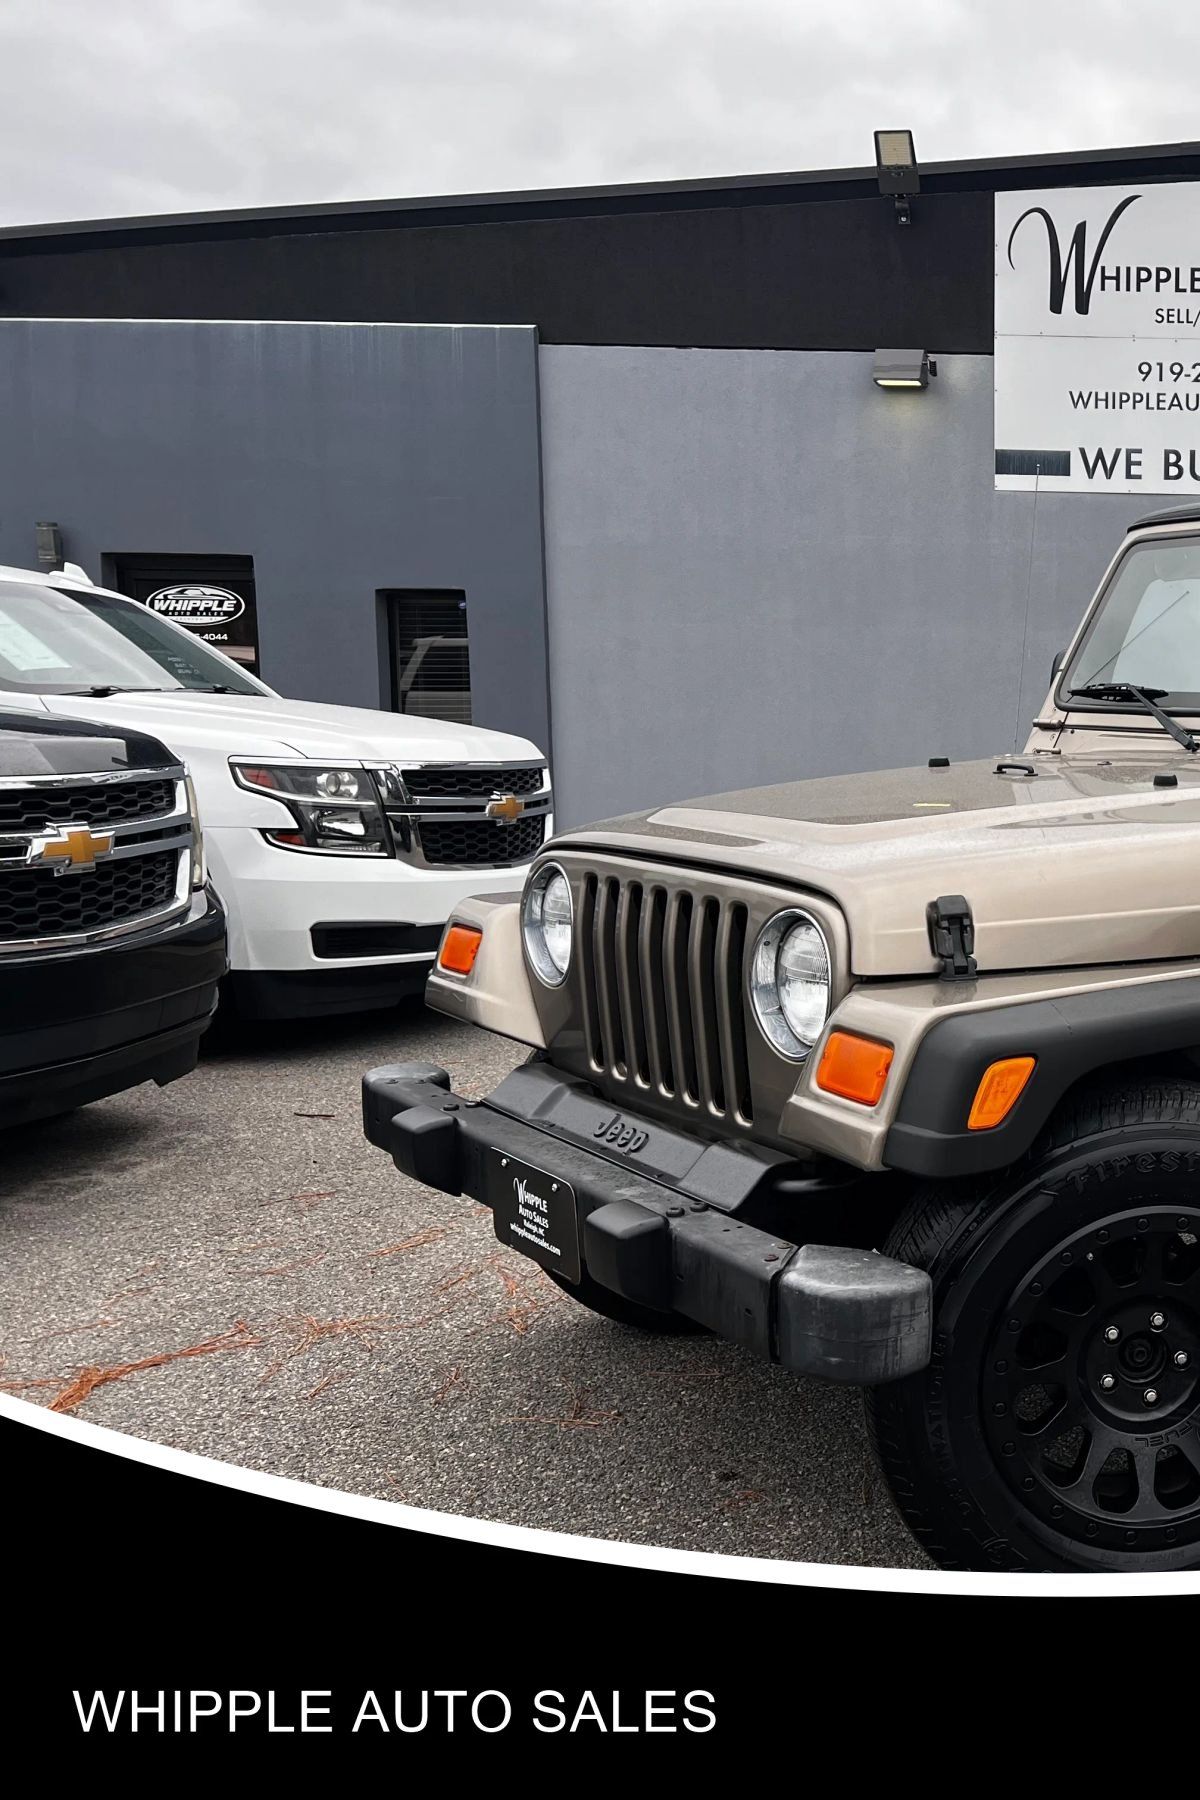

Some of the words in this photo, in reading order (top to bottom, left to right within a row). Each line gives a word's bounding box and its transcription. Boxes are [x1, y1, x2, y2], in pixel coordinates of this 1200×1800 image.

[1078, 447, 1143, 480] WE
[153, 599, 237, 612] WHIPPLE
[594, 1113, 649, 1156] Jeep
[513, 1177, 548, 1214] WHIPPLE
[518, 1204, 533, 1220] AUTO
[532, 1211, 549, 1229] SALES
